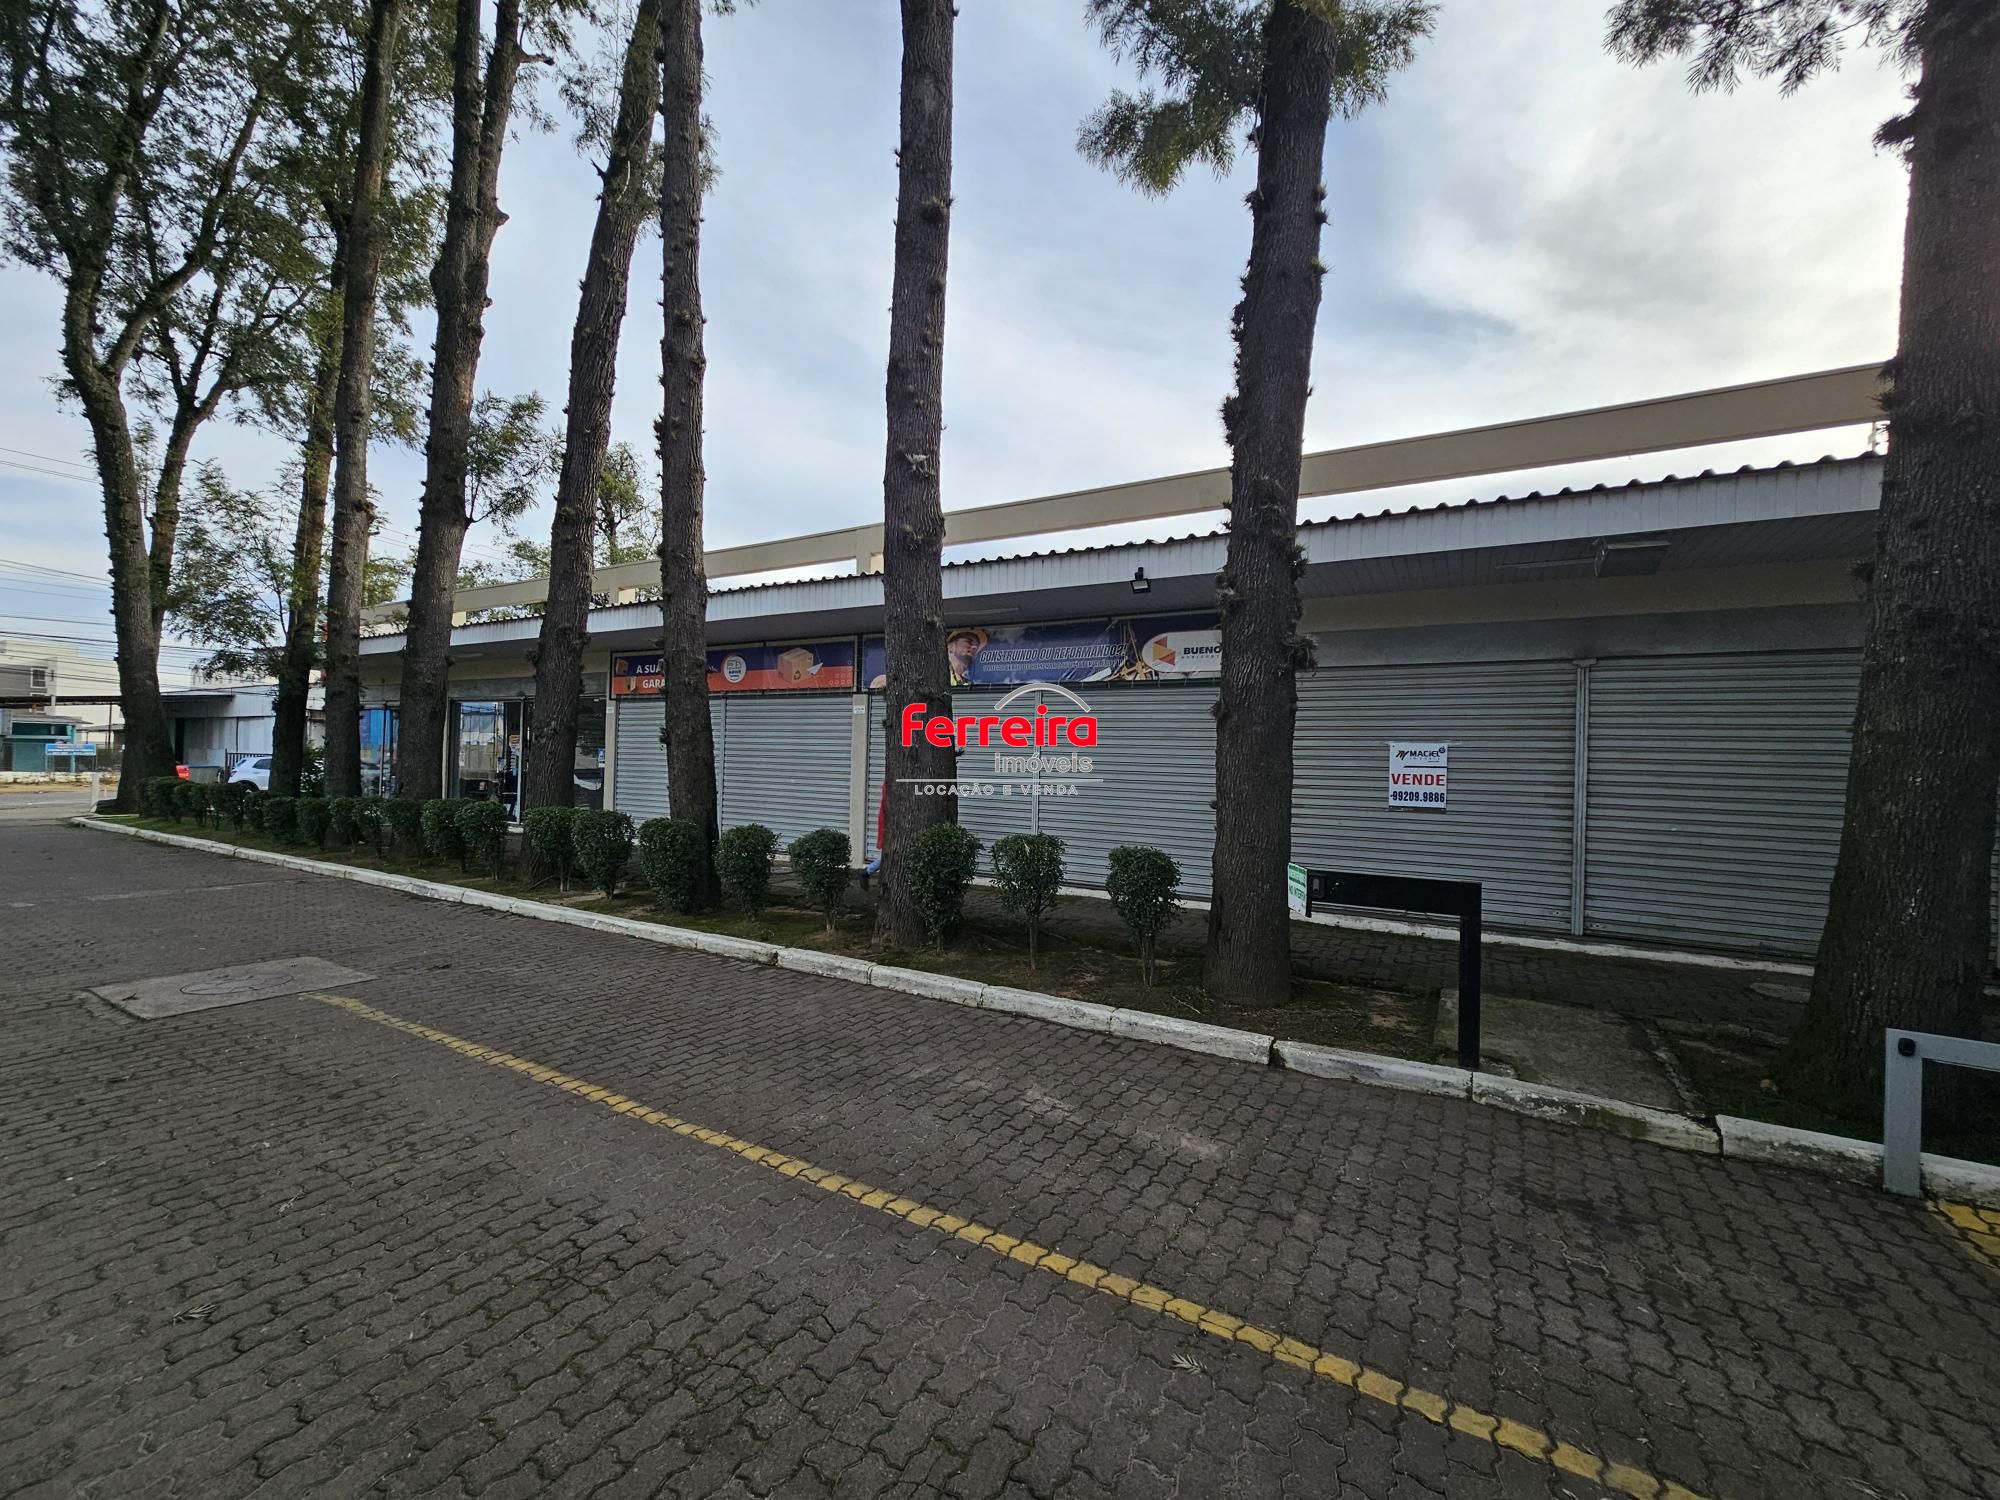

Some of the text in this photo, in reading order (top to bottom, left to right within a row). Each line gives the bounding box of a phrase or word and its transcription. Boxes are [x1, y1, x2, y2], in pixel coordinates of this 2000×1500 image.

[1040, 647, 1053, 661] OU
[1183, 645, 1222, 655] BUENO
[636, 664, 643, 674] A
[1391, 773, 1446, 786] VENDE
